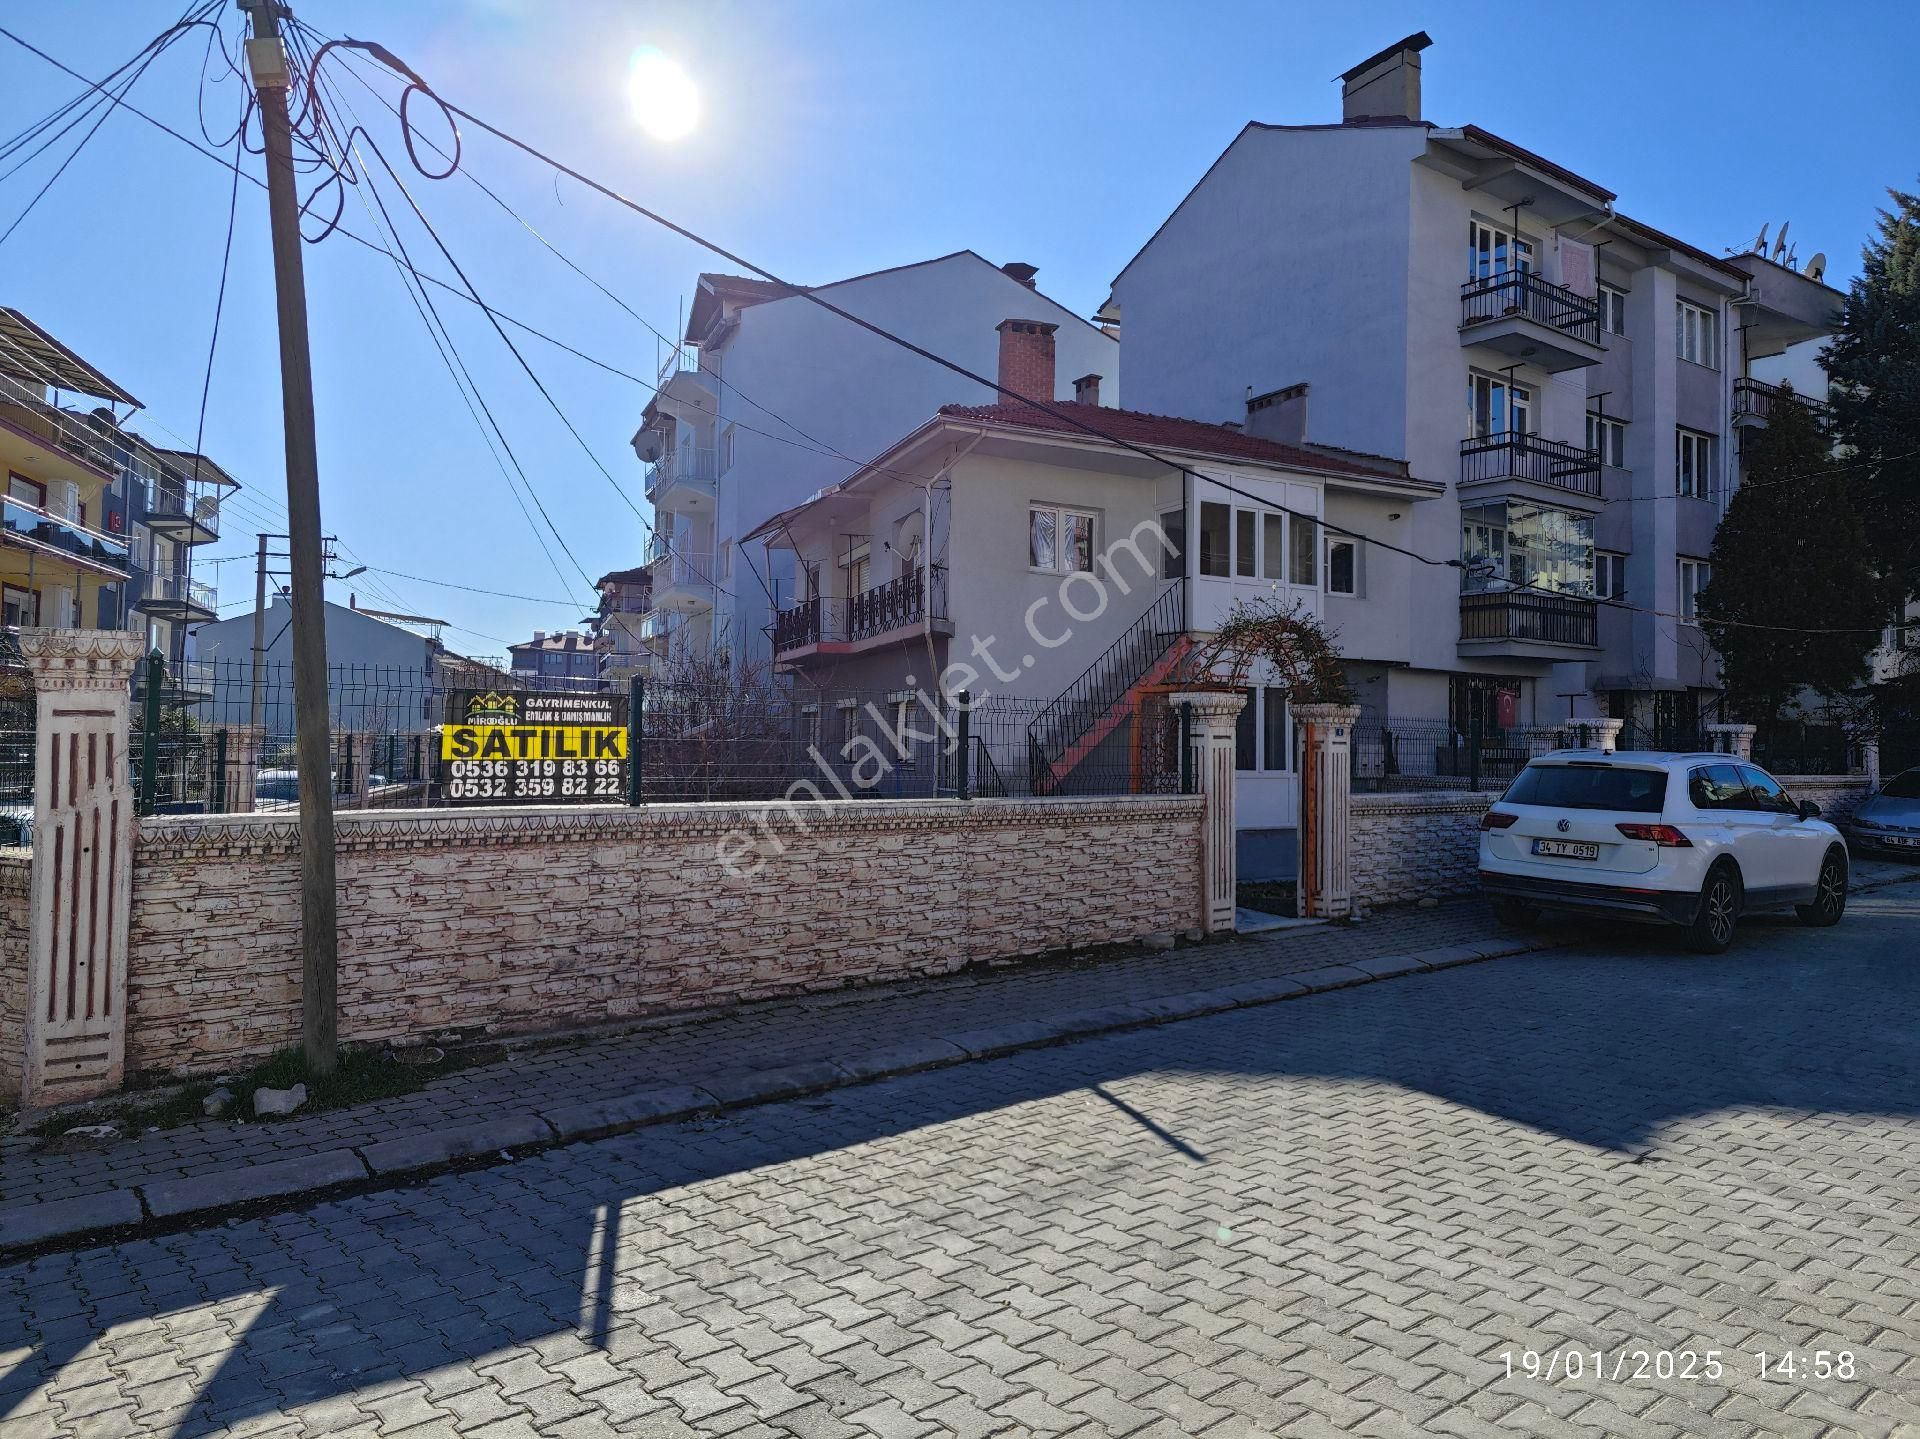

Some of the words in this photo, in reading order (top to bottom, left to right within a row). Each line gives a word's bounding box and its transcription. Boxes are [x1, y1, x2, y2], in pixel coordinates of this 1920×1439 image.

[526, 697, 612, 709] GAYRİMENKUL
[525, 711, 552, 721] EMLAK
[554, 711, 560, 721] &
[451, 728, 622, 758] SATILIK
[451, 760, 508, 777] 0536
[515, 760, 556, 777] 319
[562, 760, 588, 776] 83
[594, 760, 620, 776] 66
[450, 778, 507, 798] 0532
[514, 778, 555, 796] 359
[561, 778, 588, 795] 82
[594, 777, 620, 795] 22
[1539, 841, 1551, 852] 34
[1556, 843, 1567, 853] TY
[1573, 845, 1595, 856] 0519
